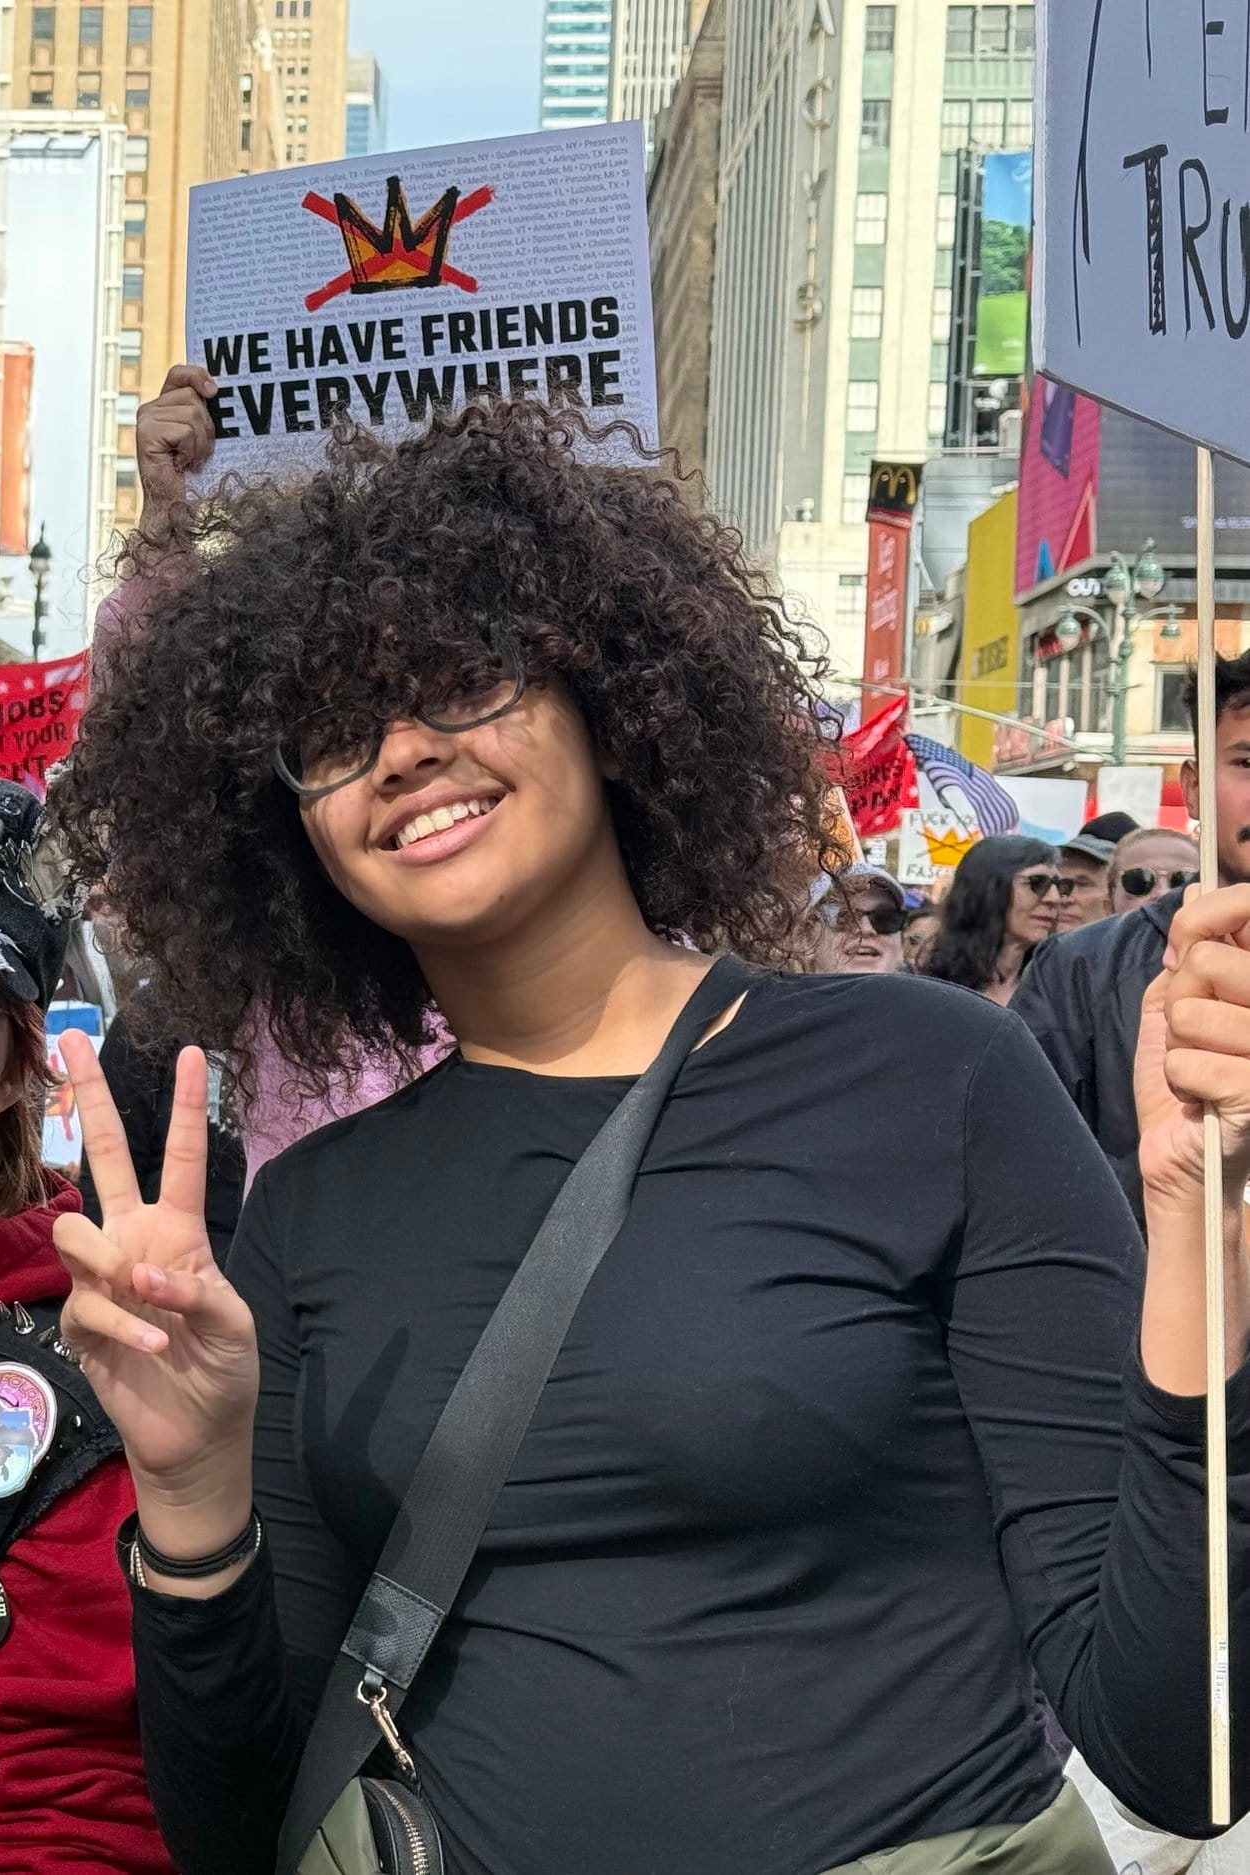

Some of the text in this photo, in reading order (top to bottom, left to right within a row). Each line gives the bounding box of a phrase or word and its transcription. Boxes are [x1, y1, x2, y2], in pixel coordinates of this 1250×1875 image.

[203, 333, 272, 378] WE
[286, 317, 405, 369] HAVE
[421, 296, 620, 357] FRIENDS
[211, 350, 625, 440] EVERYWHERE
[13, 722, 67, 751] YOUR
